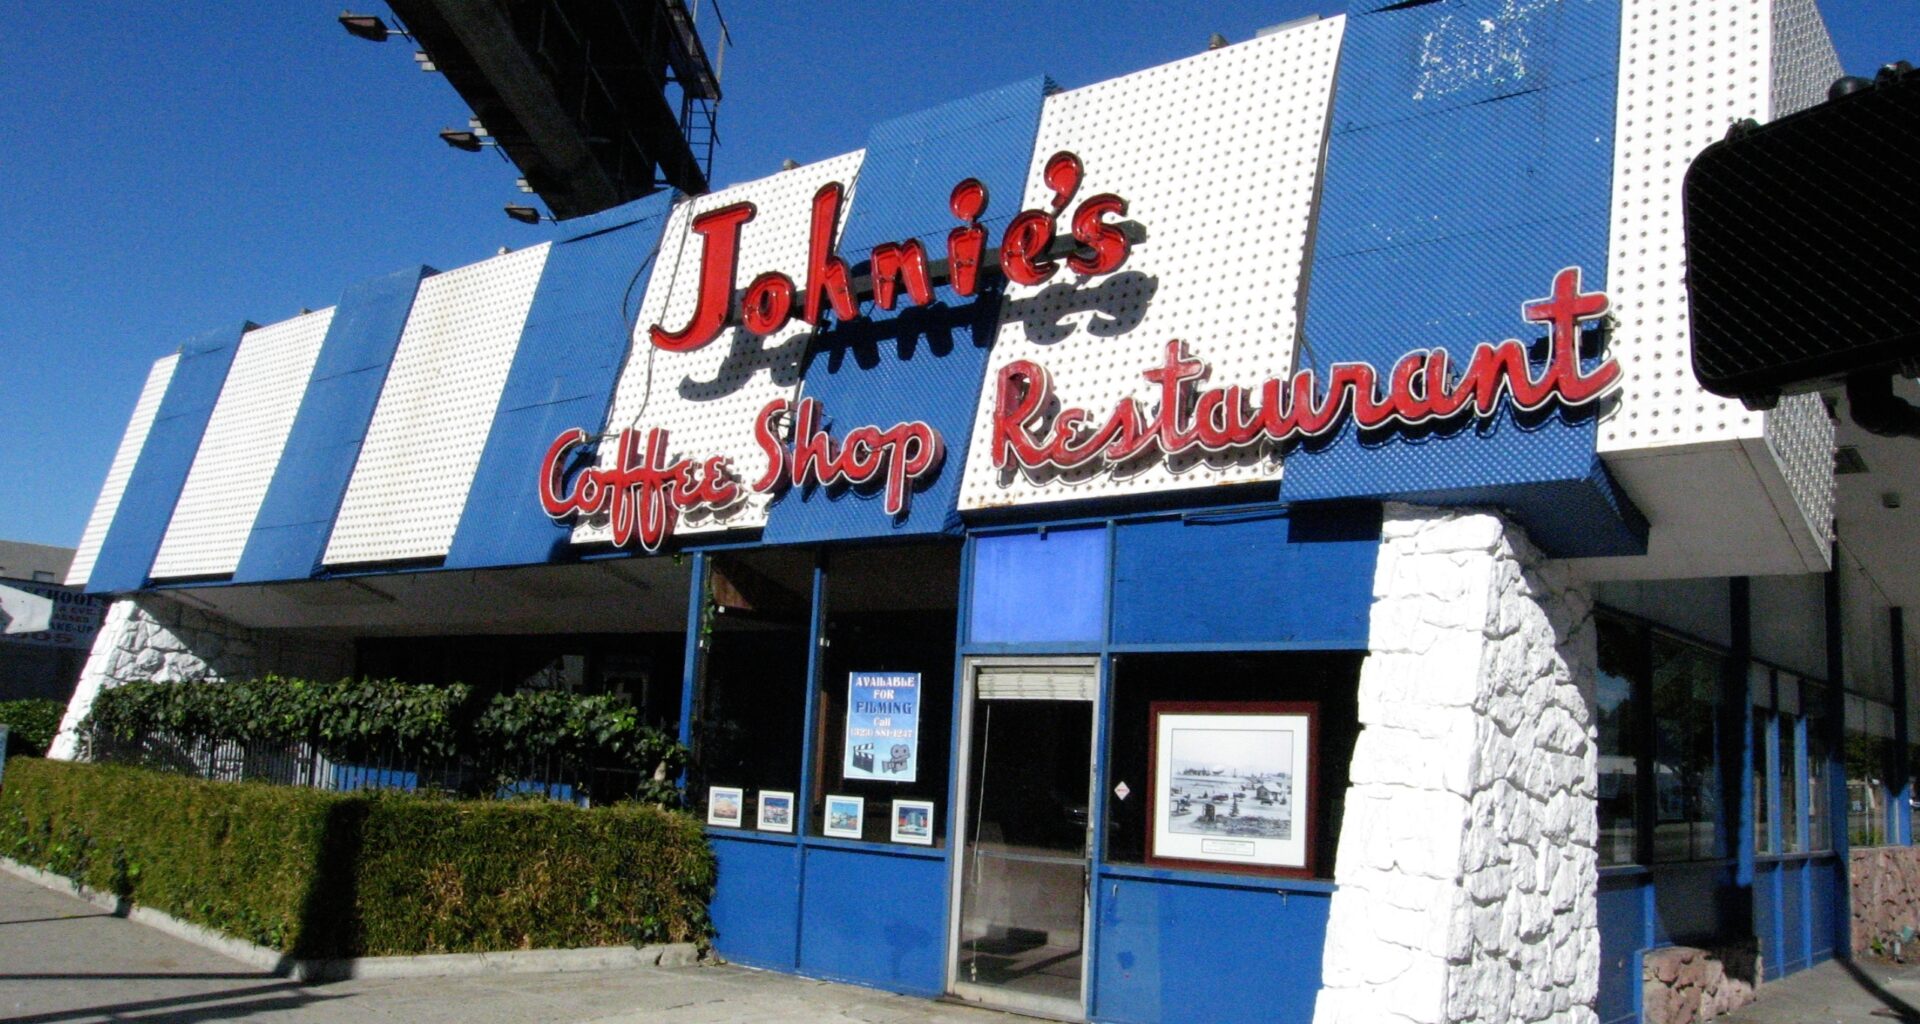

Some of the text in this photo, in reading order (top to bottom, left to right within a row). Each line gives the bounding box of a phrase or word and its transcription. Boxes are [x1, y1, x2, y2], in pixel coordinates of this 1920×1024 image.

[650, 150, 1130, 353] Johnie's
[539, 266, 1624, 551] Coffee Shop Restaurant
[855, 676, 915, 688] AVAILABLE
[873, 689, 895, 700] FOR
[855, 701, 912, 715] FILMING
[873, 717, 892, 727] Call
